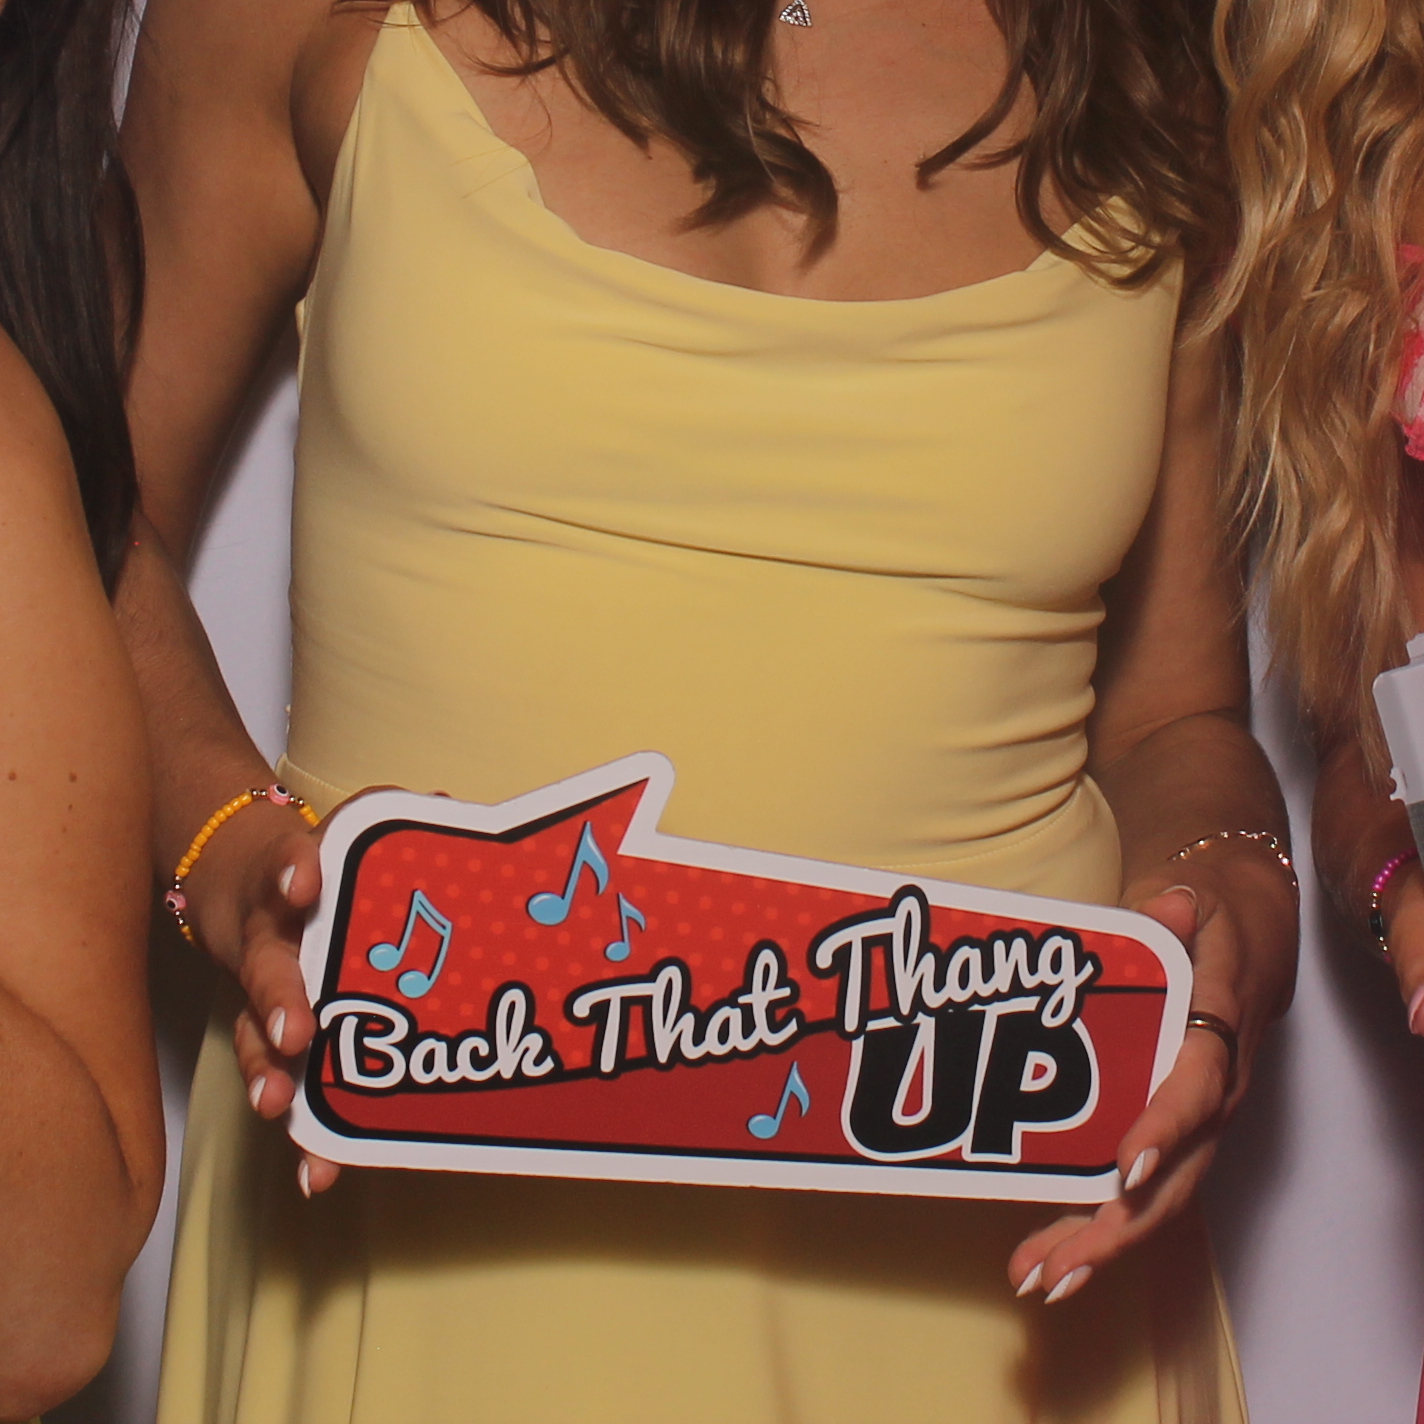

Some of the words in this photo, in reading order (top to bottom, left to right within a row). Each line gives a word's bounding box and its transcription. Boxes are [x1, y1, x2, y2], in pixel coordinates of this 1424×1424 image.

[319, 988, 555, 1089] Back
[573, 951, 796, 1073] That
[815, 895, 1094, 1033] Thang
[840, 995, 1101, 1165] UP
